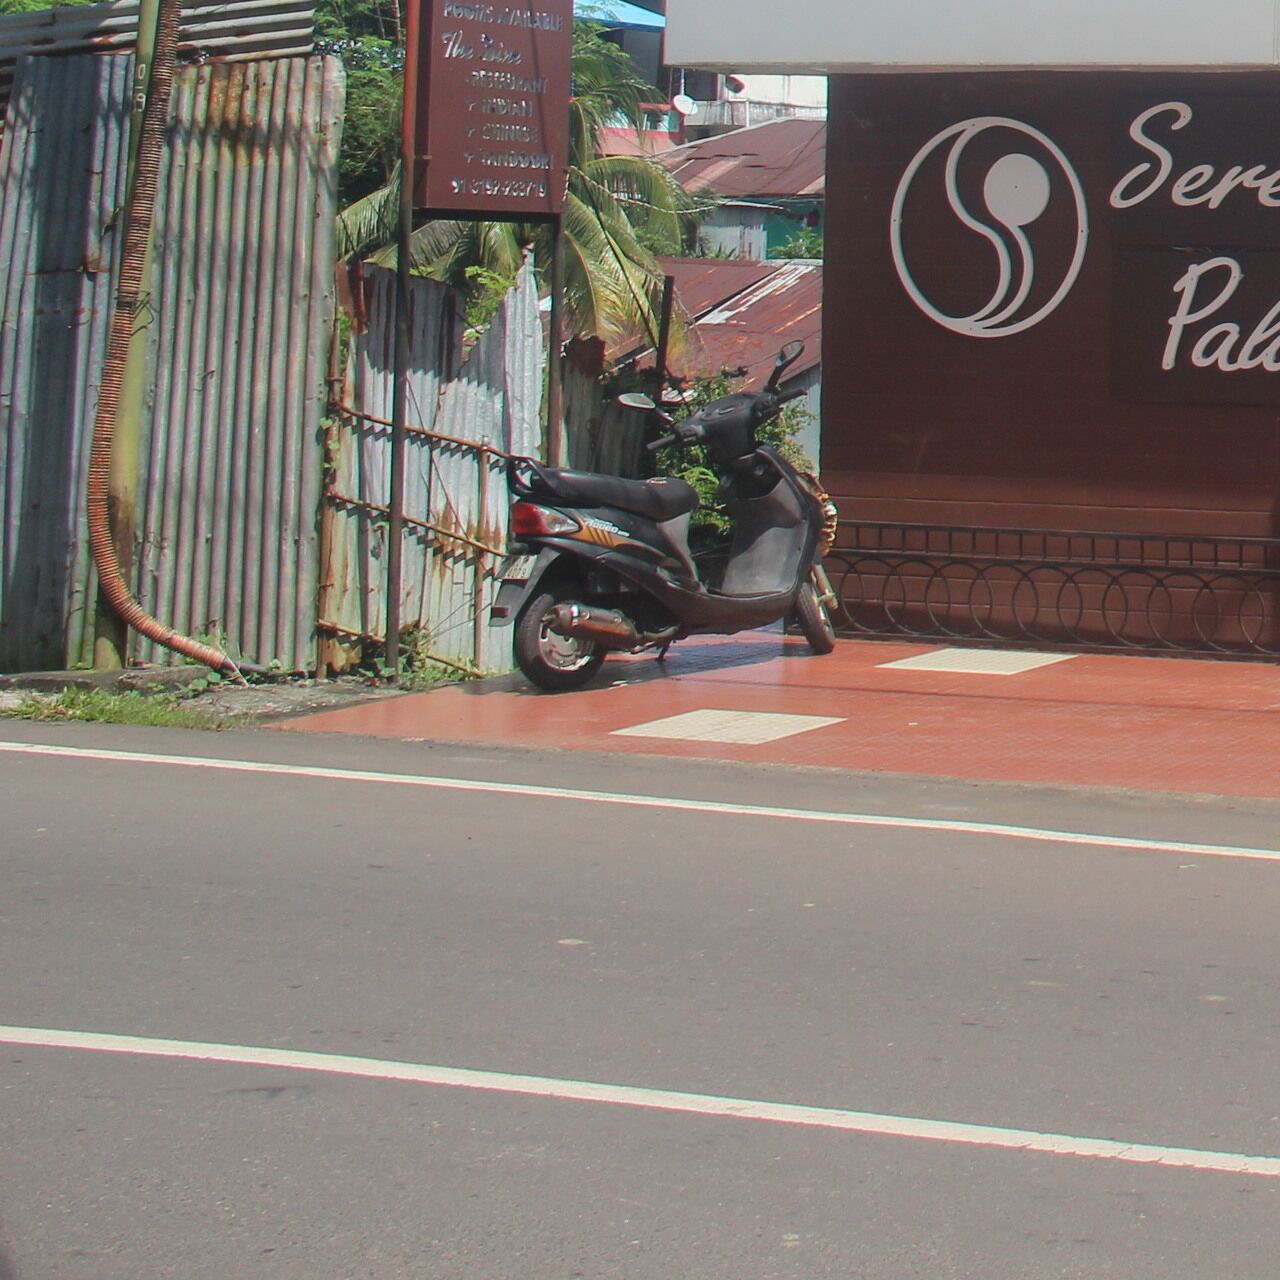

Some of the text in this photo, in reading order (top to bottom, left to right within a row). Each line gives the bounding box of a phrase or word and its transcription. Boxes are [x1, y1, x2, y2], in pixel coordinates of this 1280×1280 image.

[444, 0, 563, 32] ROOMS AVAILABLE
[441, 30, 474, 59] The
[471, 69, 548, 94] RESTAURANT
[482, 97, 533, 118] INDIAN
[482, 122, 537, 144] CHINESE
[480, 149, 554, 170] TANDOORI
